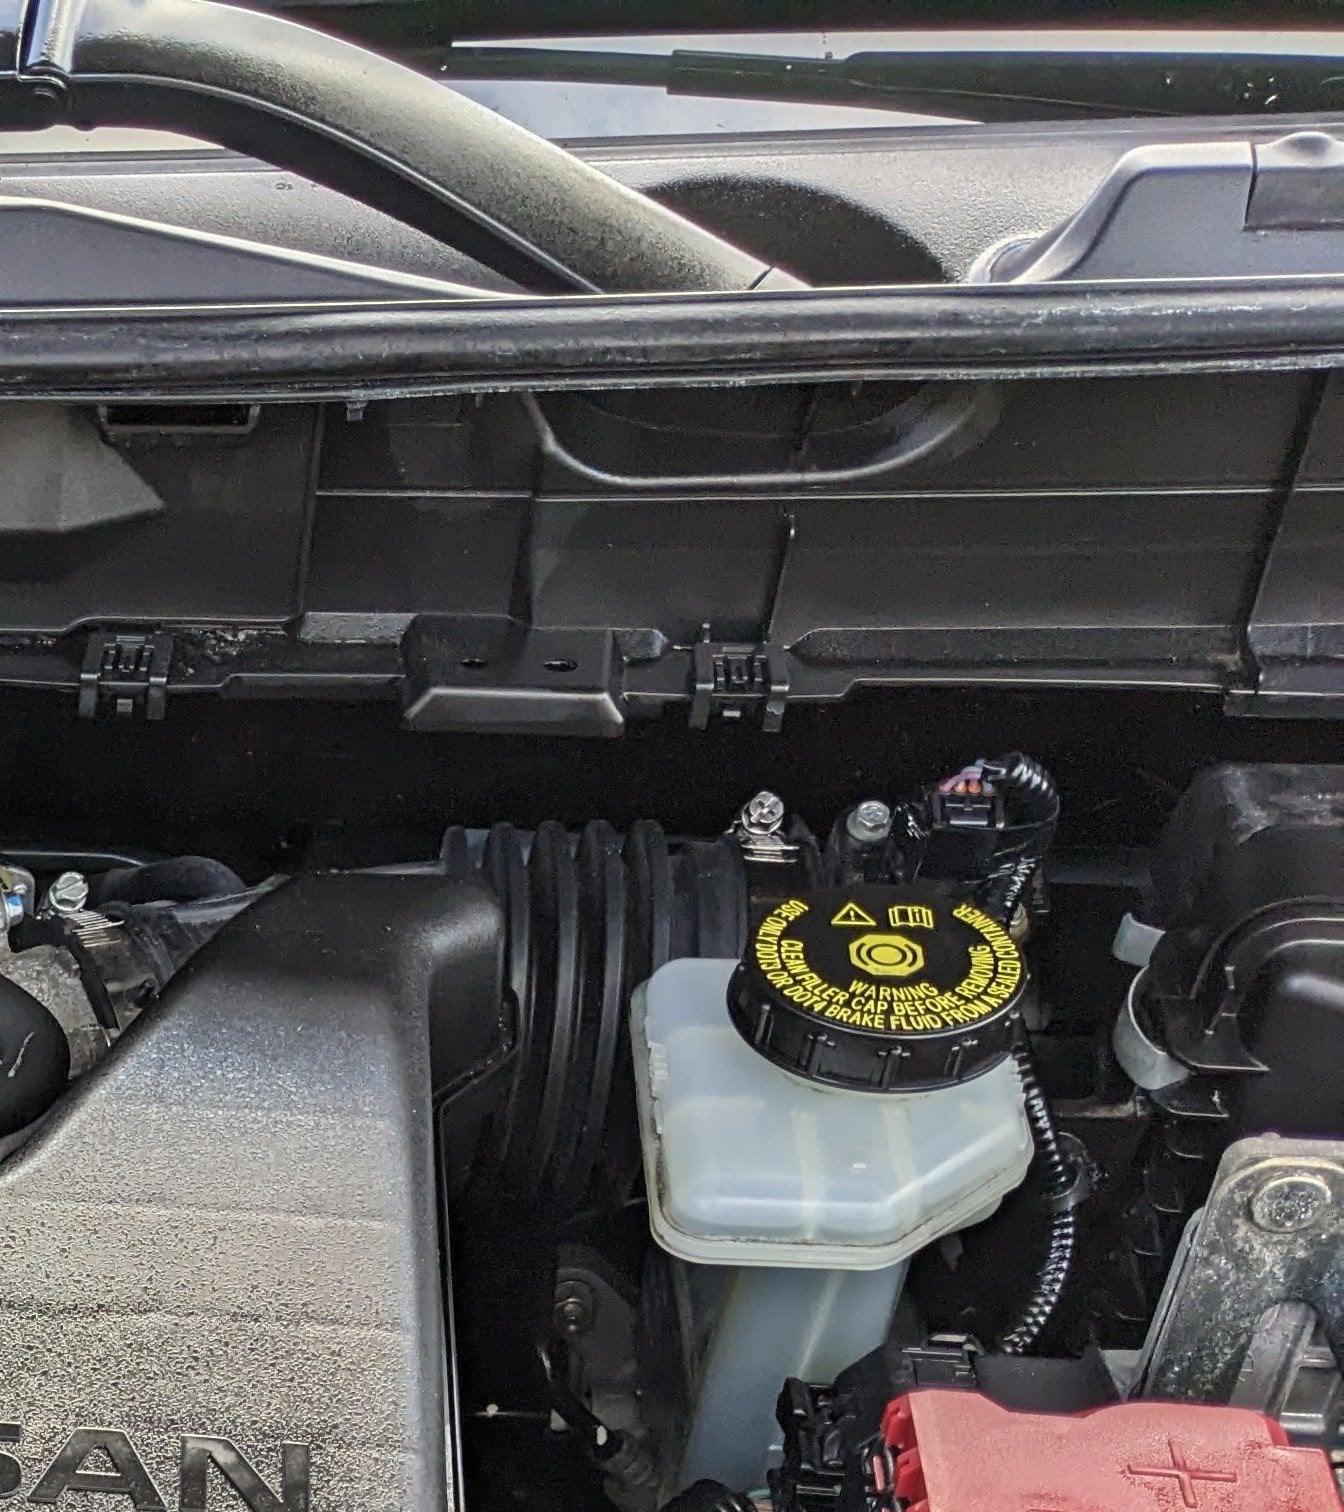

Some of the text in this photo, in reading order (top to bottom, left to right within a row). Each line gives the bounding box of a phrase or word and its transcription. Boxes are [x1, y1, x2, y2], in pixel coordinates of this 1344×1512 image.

[773, 899, 809, 922] USE
[757, 915, 787, 944] ONLY
[952, 903, 1020, 959] CONTAINER
[755, 942, 782, 972] DOT3
[766, 971, 793, 988] OR
[781, 939, 995, 1016] CLEAN FILLER CAP BEFORE REMOVING
[849, 980, 939, 1001] WARNING
[993, 960, 1022, 999] SEALED
[783, 981, 827, 1012] DOT4
[825, 1003, 885, 1030] BRAKE
[890, 1012, 943, 1030] FLUID
[944, 1001, 991, 1026] FROM
